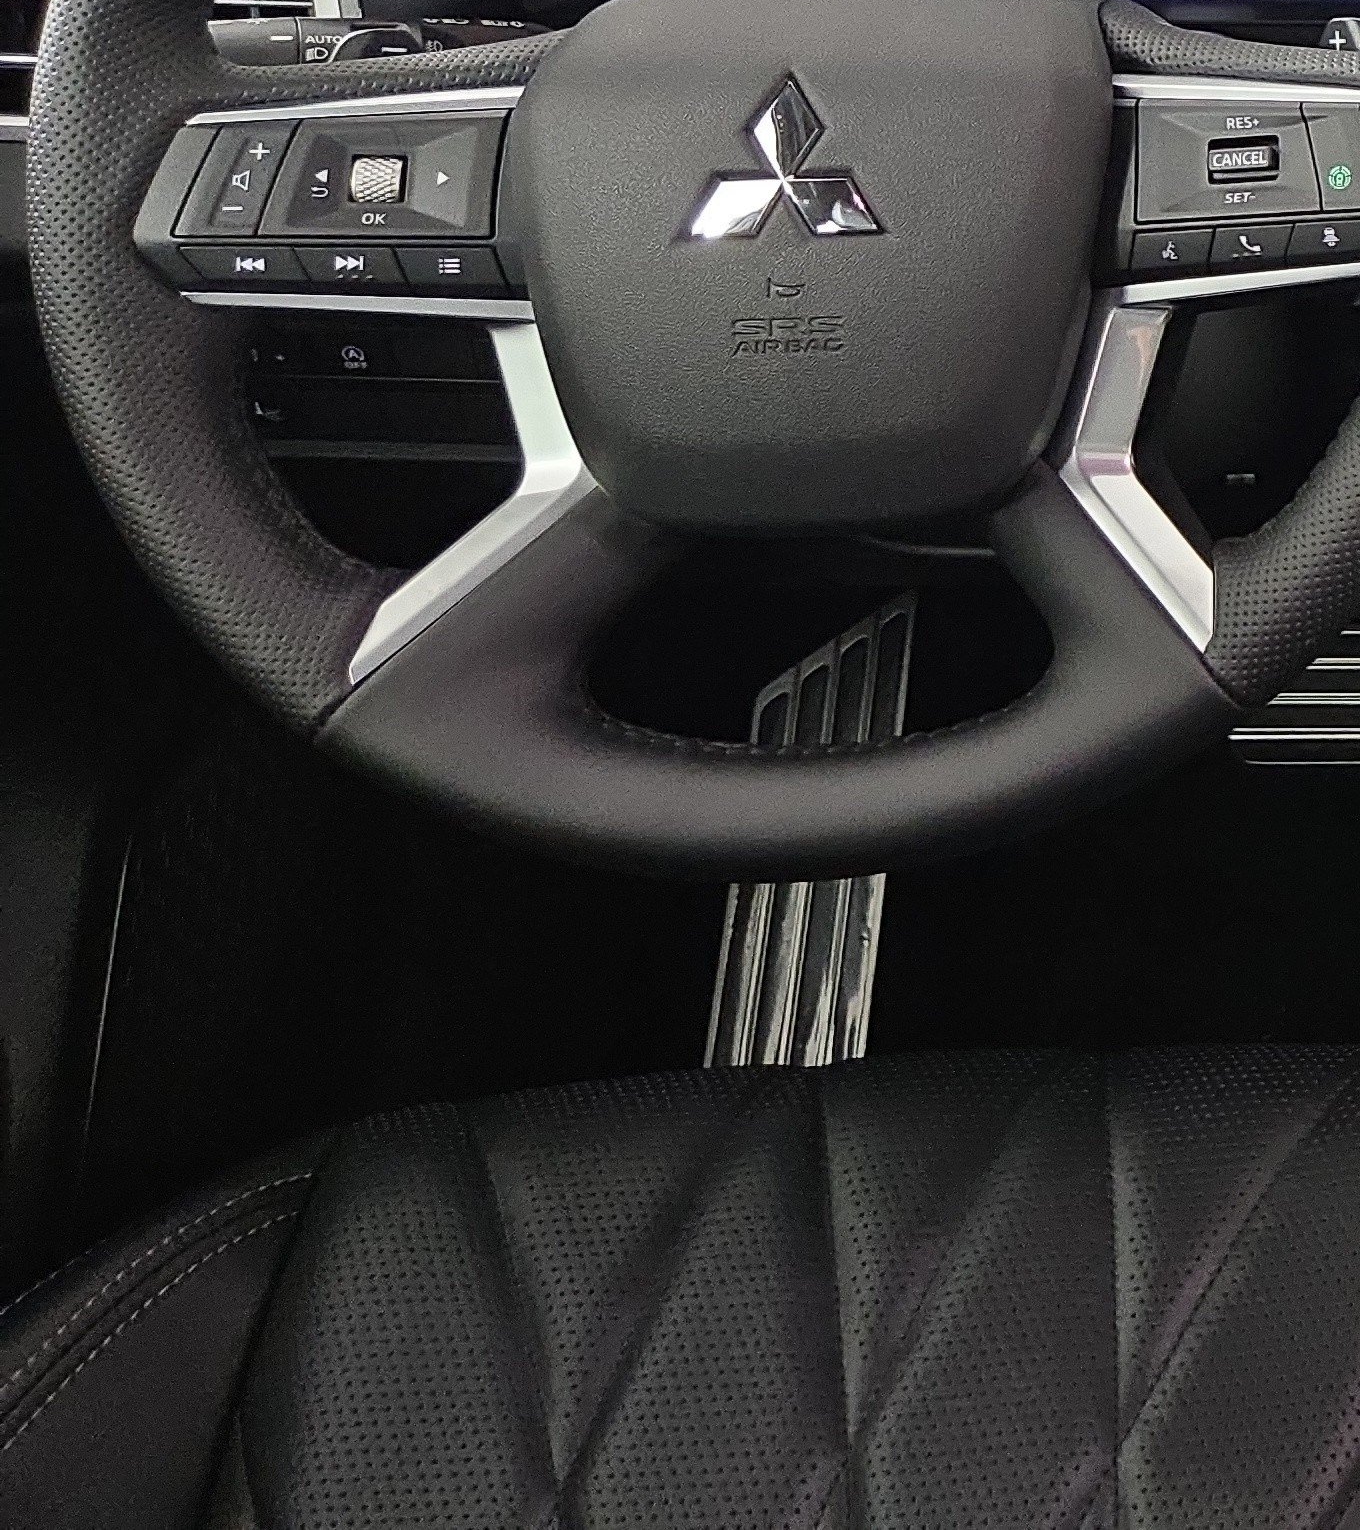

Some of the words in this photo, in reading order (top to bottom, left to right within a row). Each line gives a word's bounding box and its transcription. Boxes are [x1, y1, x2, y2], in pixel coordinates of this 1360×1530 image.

[305, 34, 342, 45] AUTO
[1212, 151, 1268, 167] CANCEL
[361, 211, 386, 227] OK
[731, 315, 845, 337] SRS
[730, 337, 845, 358] AIRBAG
